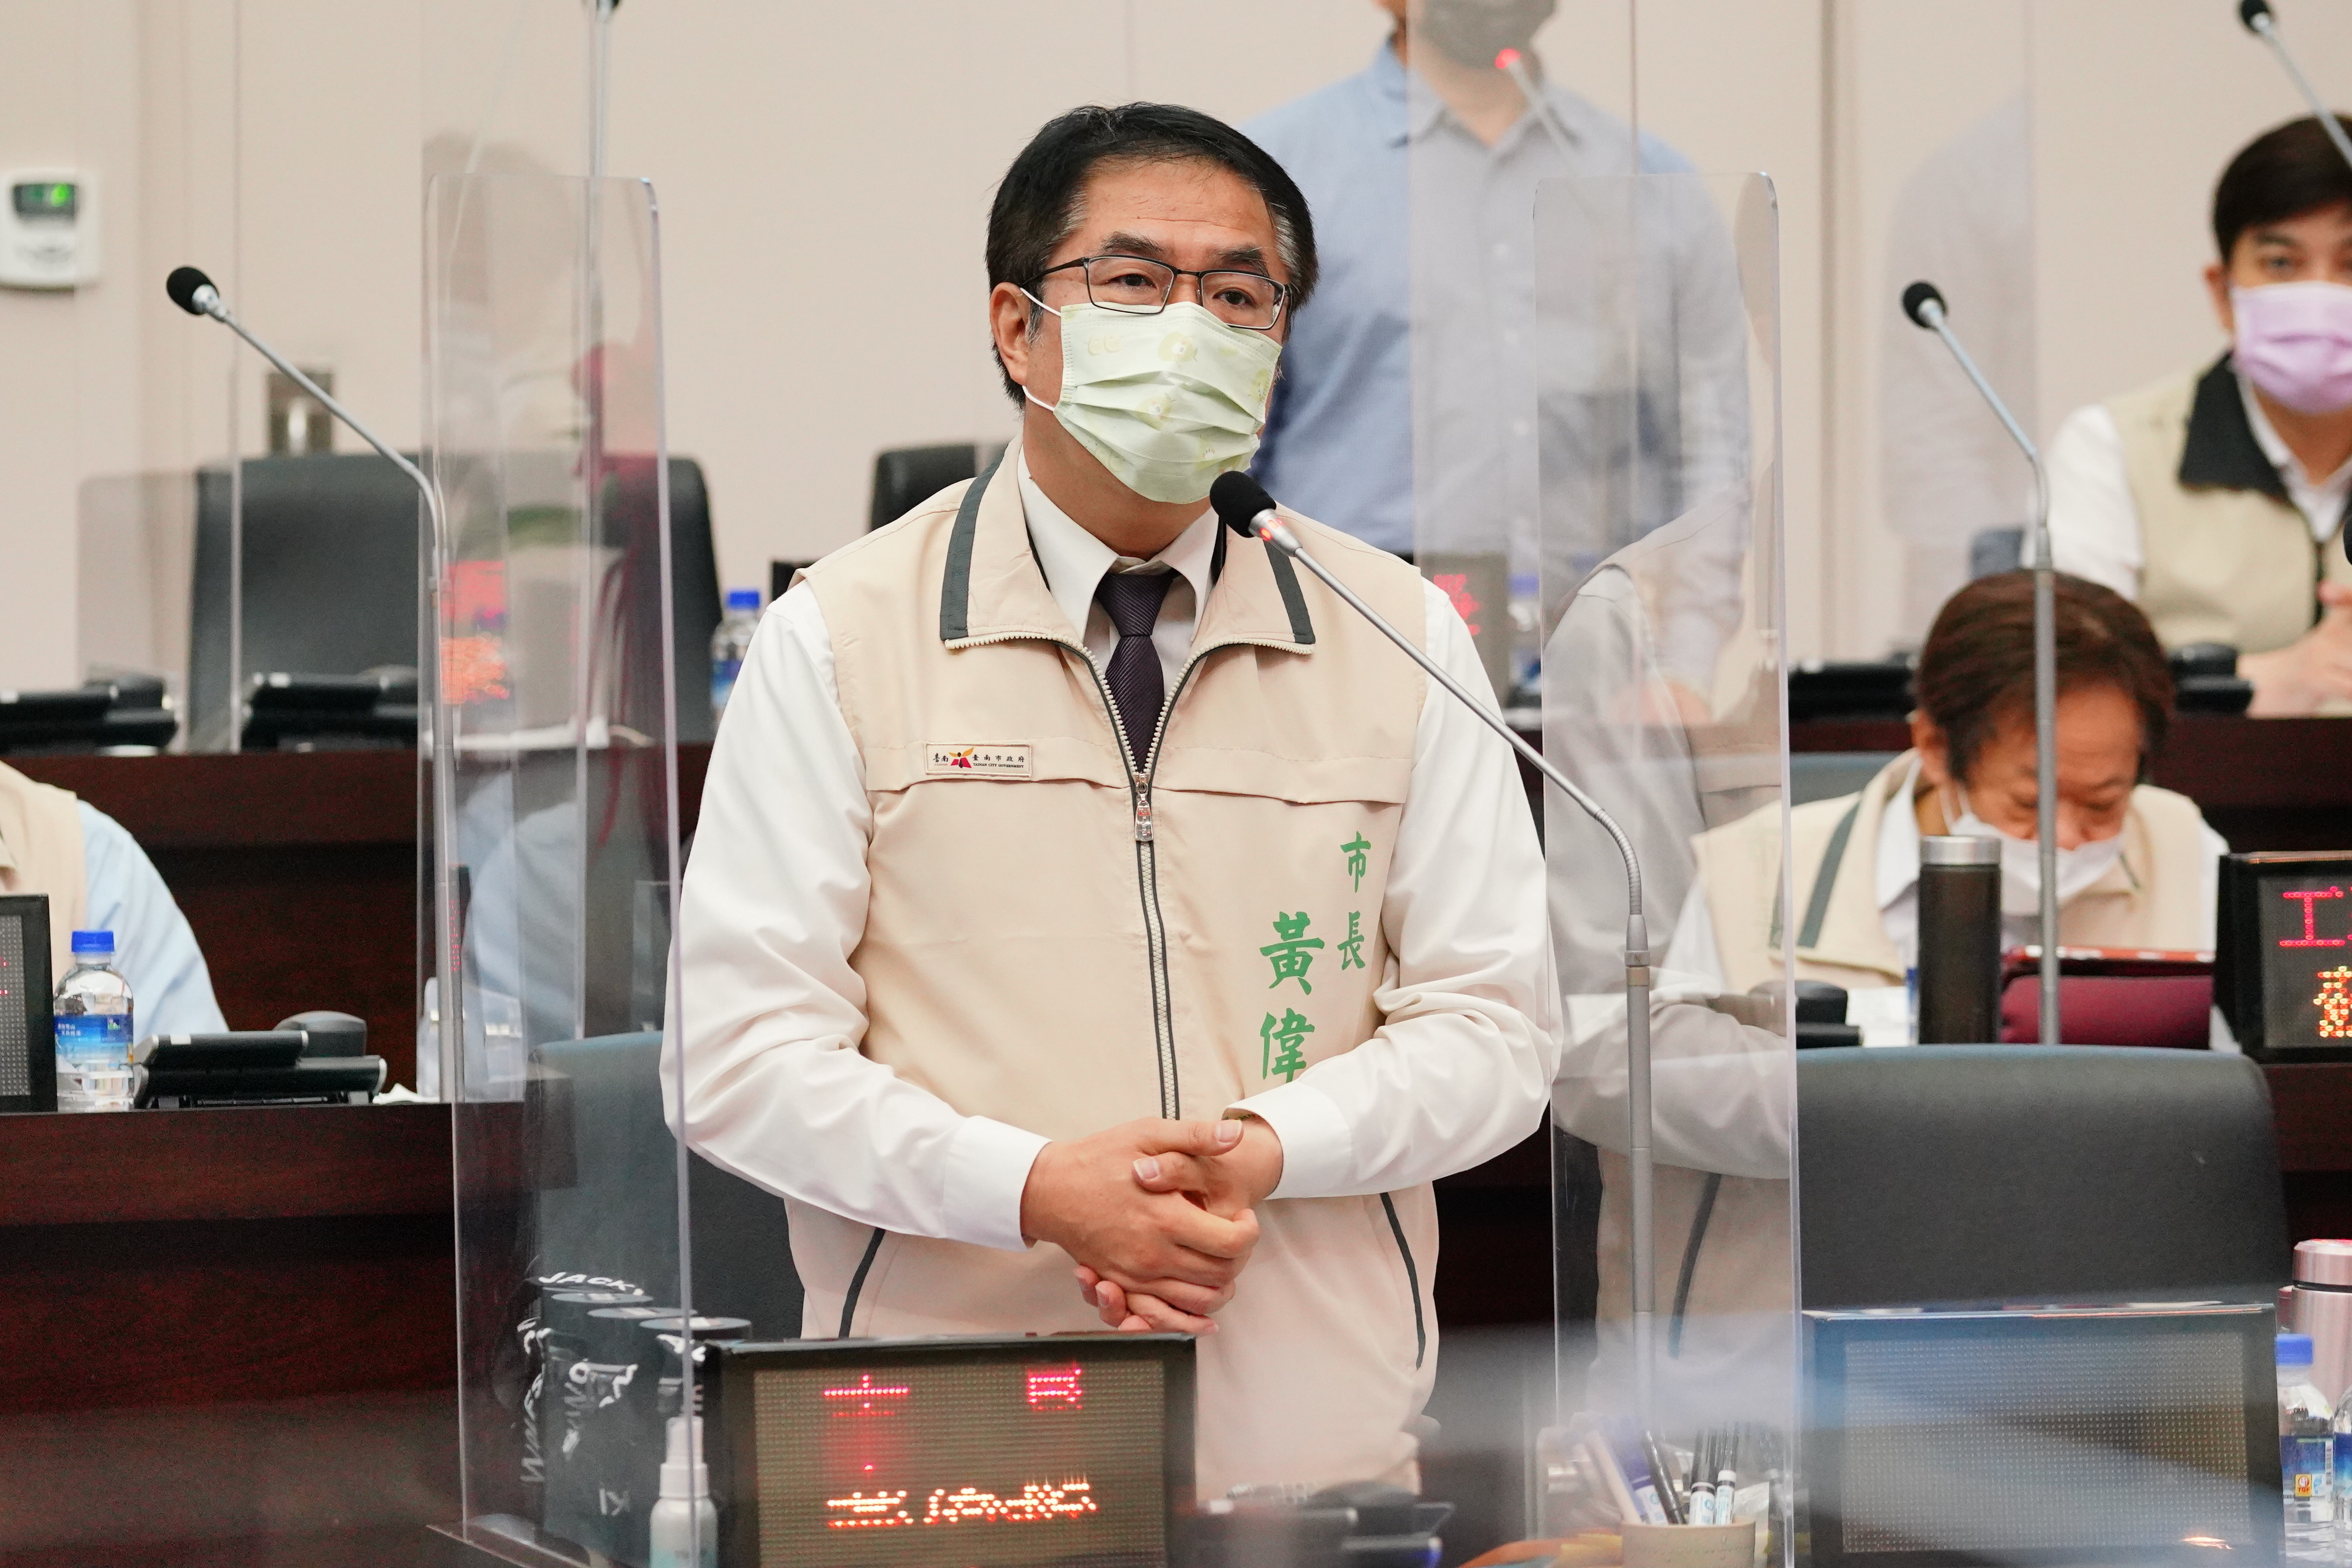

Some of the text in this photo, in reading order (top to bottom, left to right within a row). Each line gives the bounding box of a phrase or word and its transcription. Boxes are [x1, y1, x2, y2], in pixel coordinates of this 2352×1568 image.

[972, 754, 1024, 763] 臺南市政府
[1337, 830, 1371, 971] 市長
[2279, 886, 2352, 947] 工
